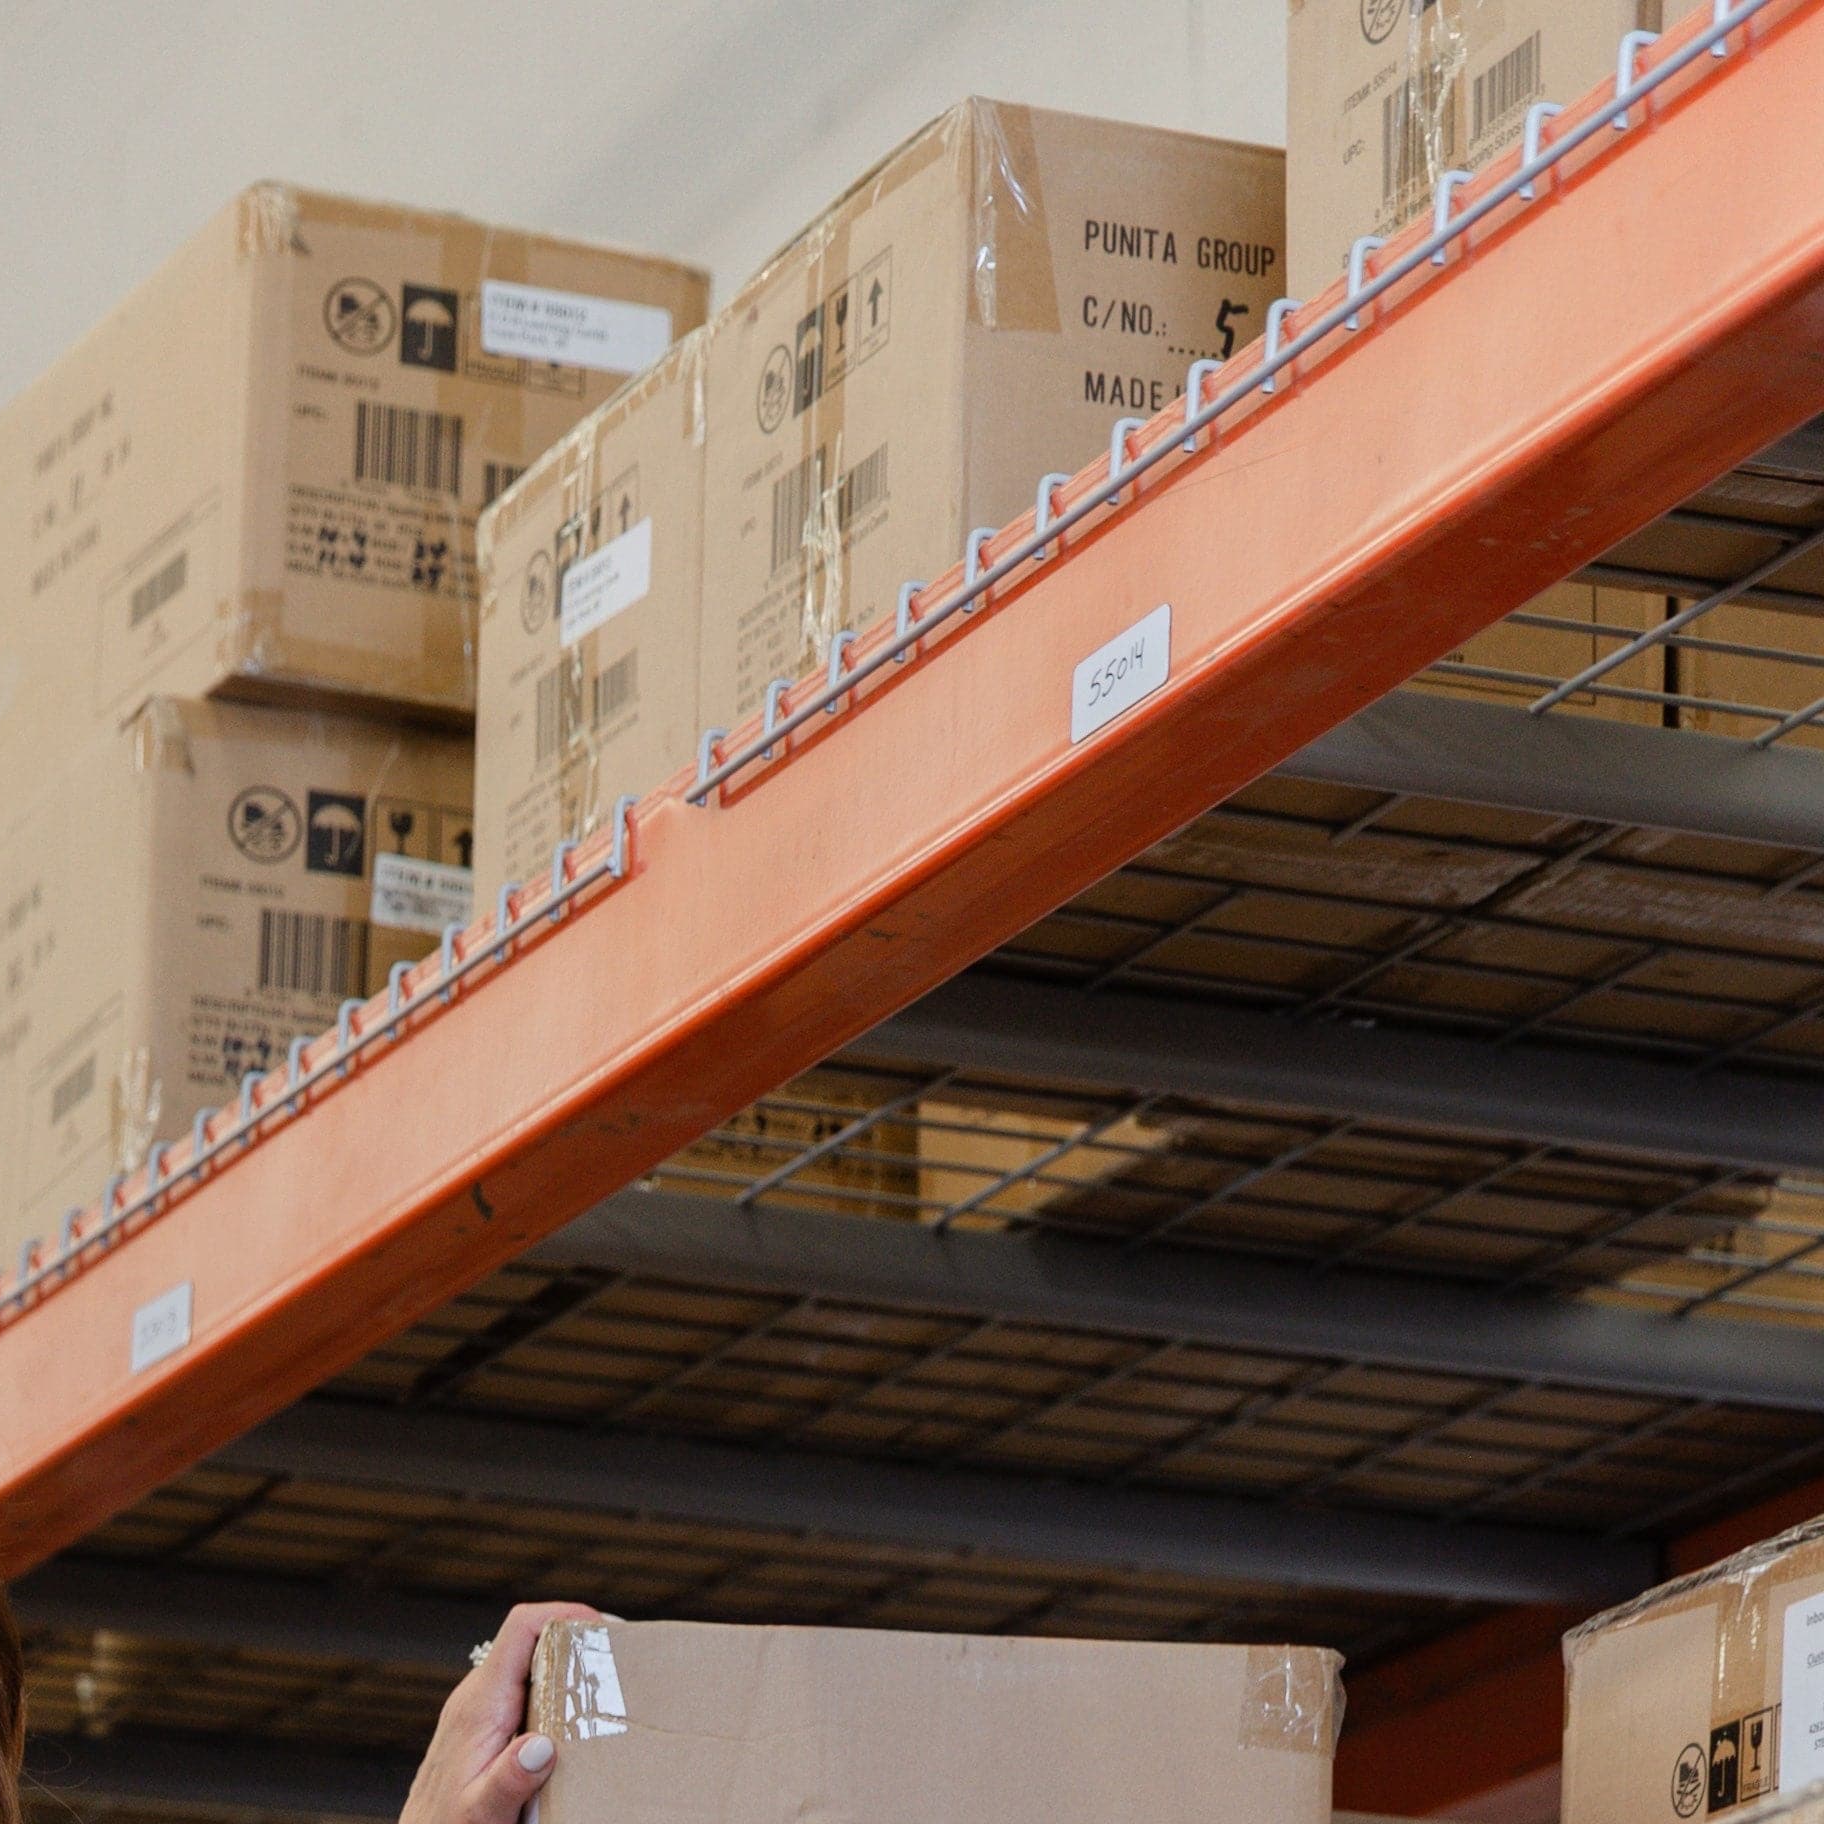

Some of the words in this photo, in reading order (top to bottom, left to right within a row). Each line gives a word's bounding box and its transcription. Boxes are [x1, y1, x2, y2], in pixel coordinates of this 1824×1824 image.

[1085, 220, 1177, 264] PUNITA
[1197, 237, 1275, 276] GROUP
[1084, 371, 1163, 411] MADE
[1089, 637, 1145, 706] 55014
